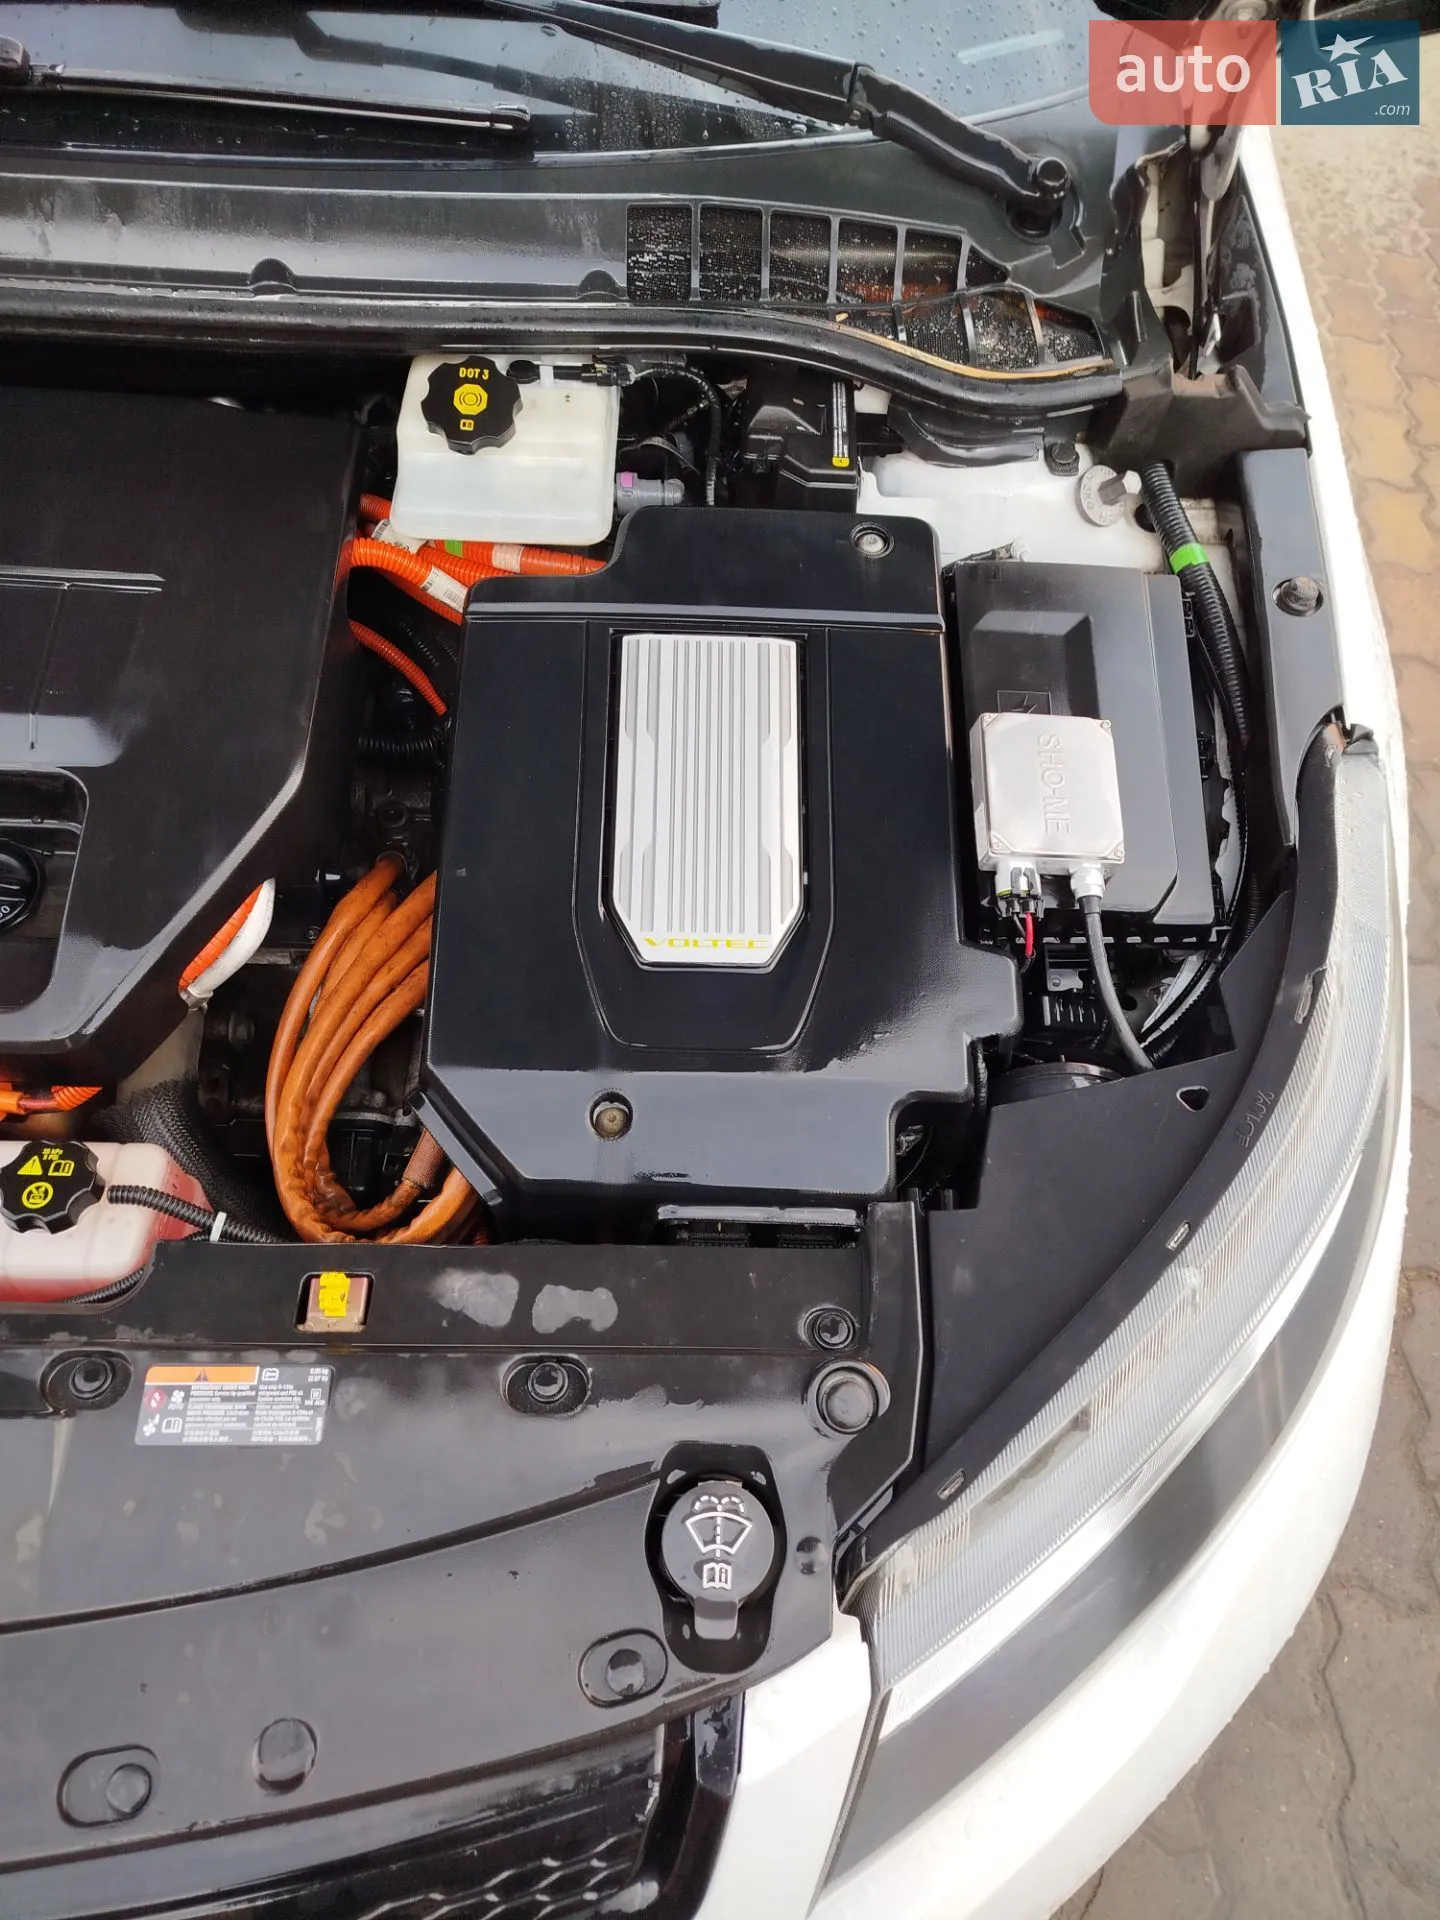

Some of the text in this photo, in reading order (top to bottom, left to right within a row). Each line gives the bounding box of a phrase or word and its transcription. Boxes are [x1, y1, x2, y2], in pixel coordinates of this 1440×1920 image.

[459, 368, 490, 380] DOT 3
[1038, 734, 1071, 834] SHO-ME
[645, 937, 769, 949] VOLTEC
